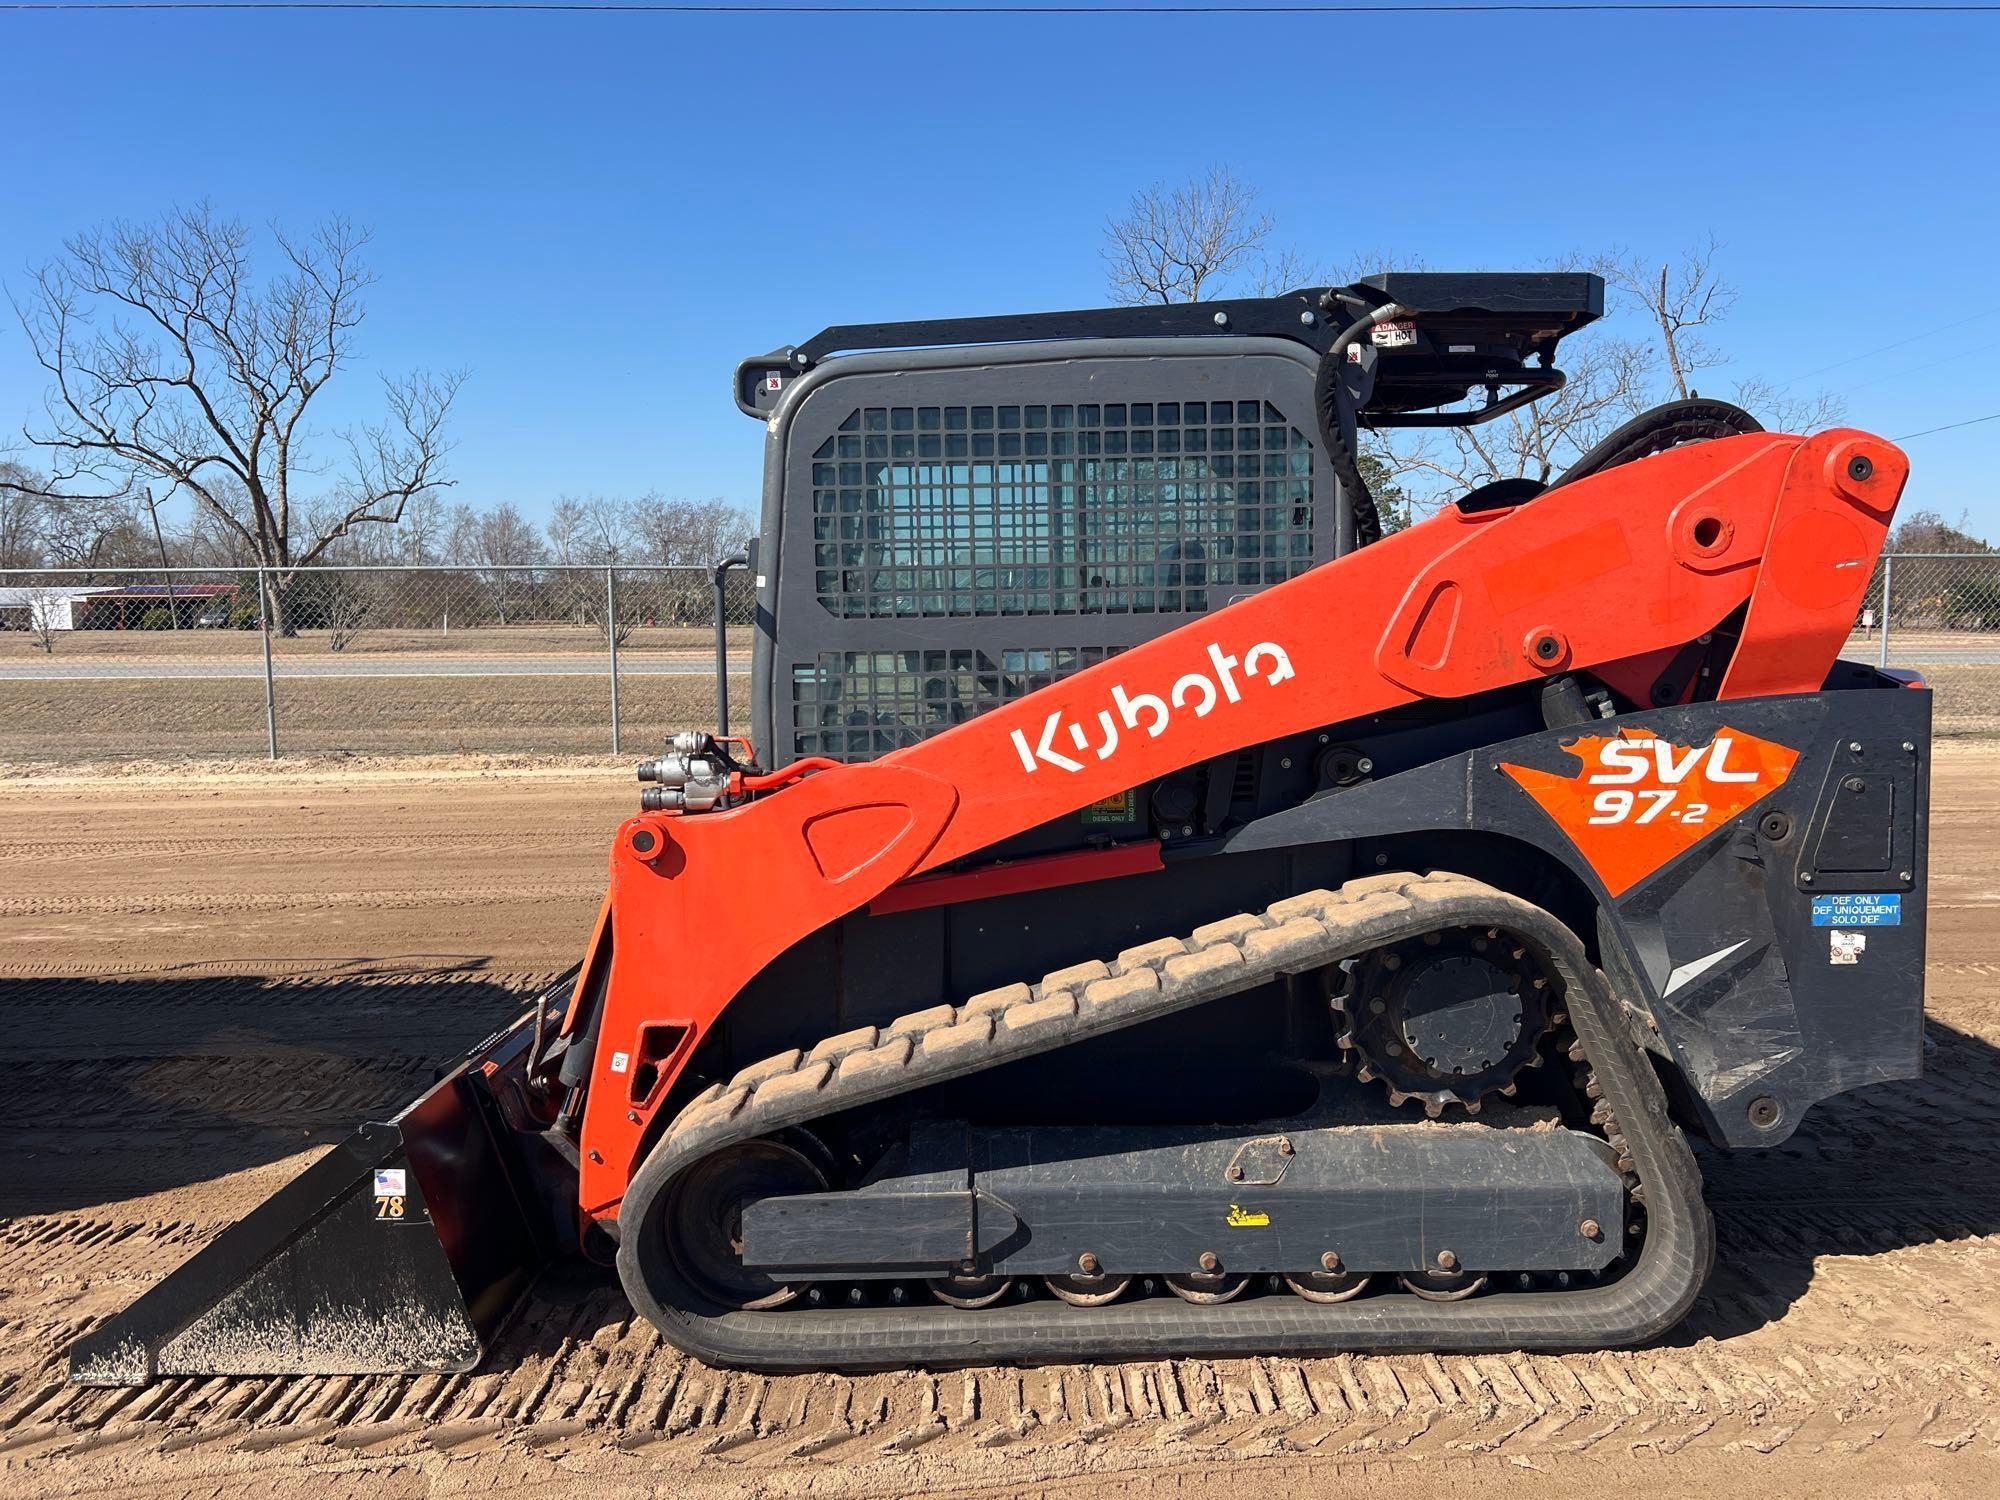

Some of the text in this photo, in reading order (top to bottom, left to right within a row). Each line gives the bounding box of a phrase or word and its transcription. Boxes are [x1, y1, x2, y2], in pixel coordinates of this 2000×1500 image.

[1382, 321, 1413, 331] DANGER
[1395, 330, 1412, 340] HOT
[1010, 642, 1295, 773] Kubota
[1588, 737, 1760, 784] SVL
[1588, 789, 1709, 824] 97-2
[1832, 896, 1880, 905] DEF ONLY
[1813, 905, 1899, 915] DEF UNIQUEMENT
[1832, 915, 1880, 924] SOLO DEF
